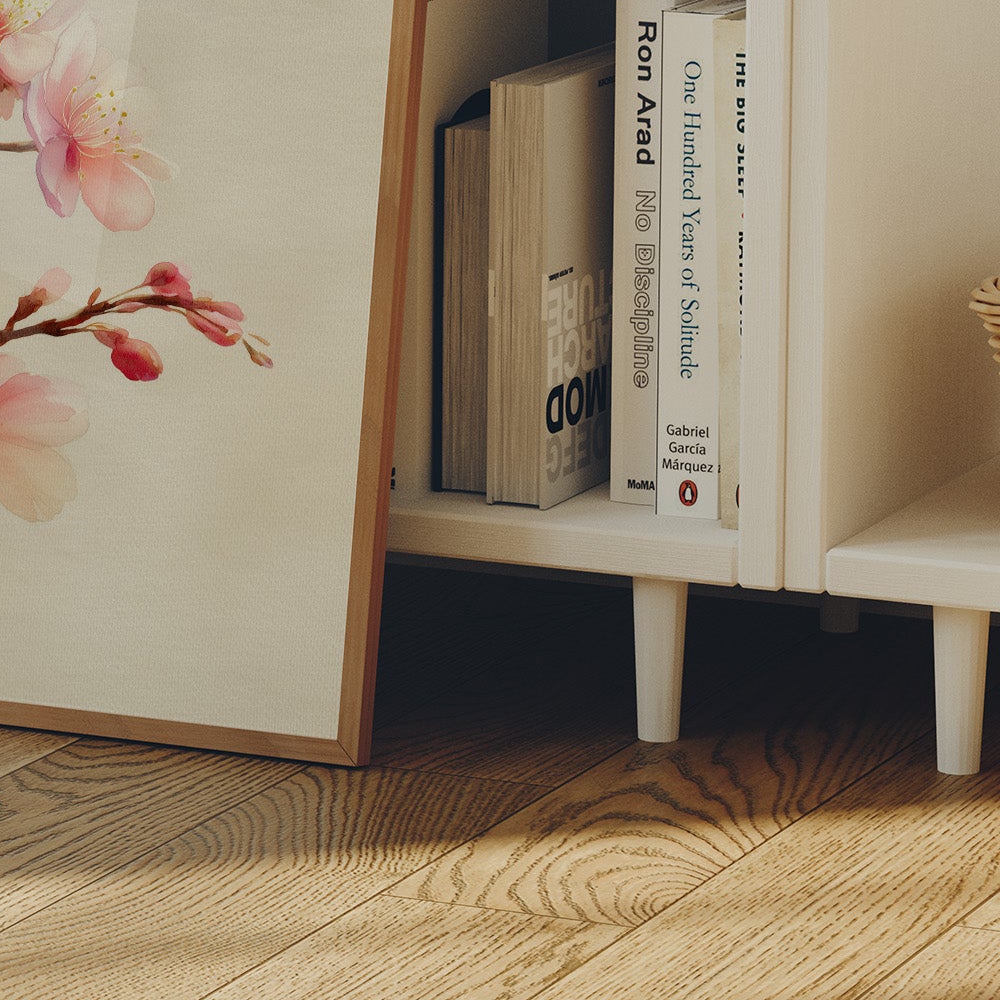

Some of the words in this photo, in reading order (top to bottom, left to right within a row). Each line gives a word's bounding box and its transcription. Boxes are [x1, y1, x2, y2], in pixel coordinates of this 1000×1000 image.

[636, 21, 657, 81] Ron
[684, 60, 702, 104] One
[636, 92, 657, 165] Arad
[682, 112, 702, 200] Hundred
[635, 190, 656, 232] No
[681, 208, 701, 261] Years
[681, 268, 700, 292] of
[630, 243, 656, 389] Discipline
[680, 298, 699, 379] Solitude
[666, 424, 709, 438] Gabriel
[668, 441, 706, 455] García
[627, 479, 655, 490] MoMA
[662, 458, 713, 473] Márquez
